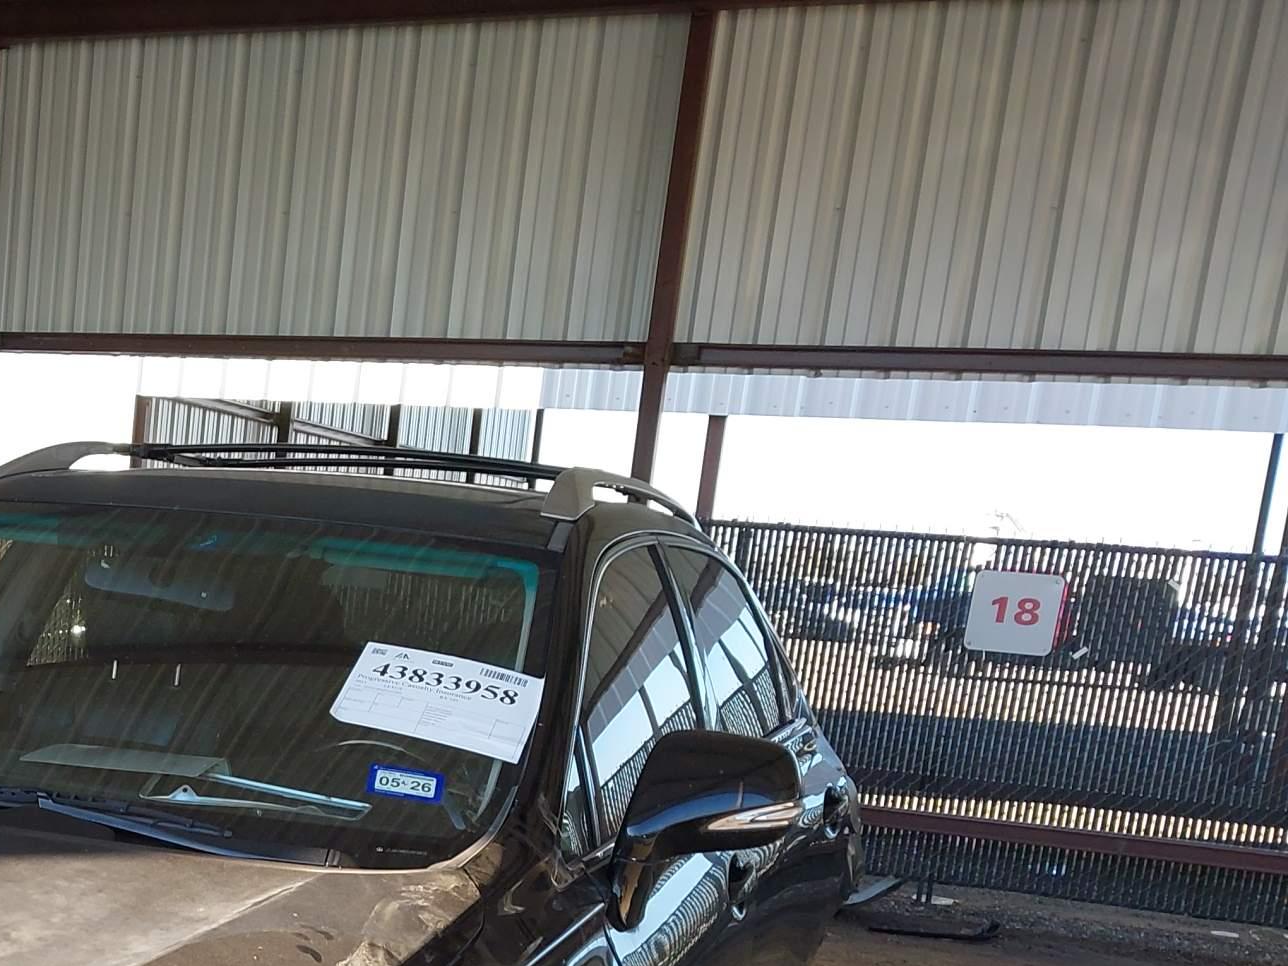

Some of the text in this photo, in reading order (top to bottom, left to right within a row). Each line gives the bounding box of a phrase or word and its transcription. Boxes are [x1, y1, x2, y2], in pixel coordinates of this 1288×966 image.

[991, 596, 1041, 626] 18
[372, 663, 520, 706] 43833958
[379, 776, 401, 788] 05
[410, 780, 432, 793] 26
